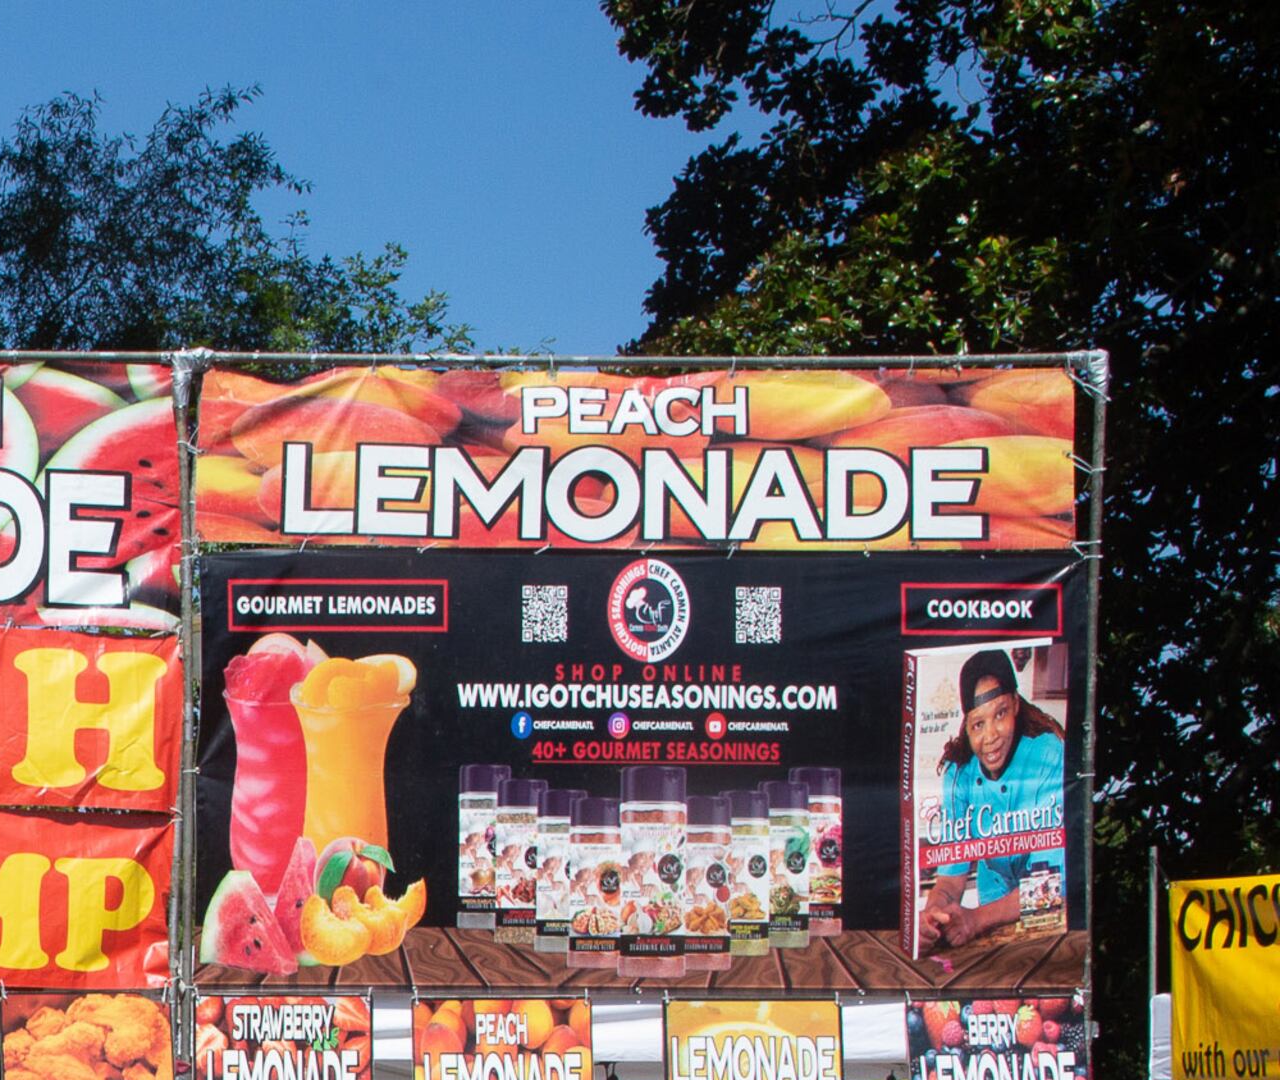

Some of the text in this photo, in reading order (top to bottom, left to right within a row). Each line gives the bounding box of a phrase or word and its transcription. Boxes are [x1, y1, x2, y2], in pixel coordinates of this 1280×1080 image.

[521, 385, 749, 437] PEACH
[281, 441, 990, 542] LEMONADE
[648, 564, 671, 580] CHEF
[236, 595, 436, 615] GOURMET LEMONADES
[927, 599, 1033, 618] COOKBOOK
[555, 664, 742, 683] SHOP ONLINE
[457, 683, 837, 711] WWW.IGOTCHUSEASONINGS.COM
[533, 720, 594, 731] CHEFCARMENATL
[632, 720, 694, 731] CHEFCARMENATL
[728, 721, 789, 732] CHEFCARMENATL
[532, 742, 780, 760] 40+ GOURMET SEASONINGS
[926, 795, 1063, 845] Chef Carmen's
[926, 831, 1063, 865] SIMPLE AND EASY FAVORITES
[231, 1004, 335, 1044] STRAWBERRY
[474, 1012, 528, 1046] PEACH
[967, 1013, 1021, 1047] BERRY
[1182, 1041, 1269, 1079] with our
